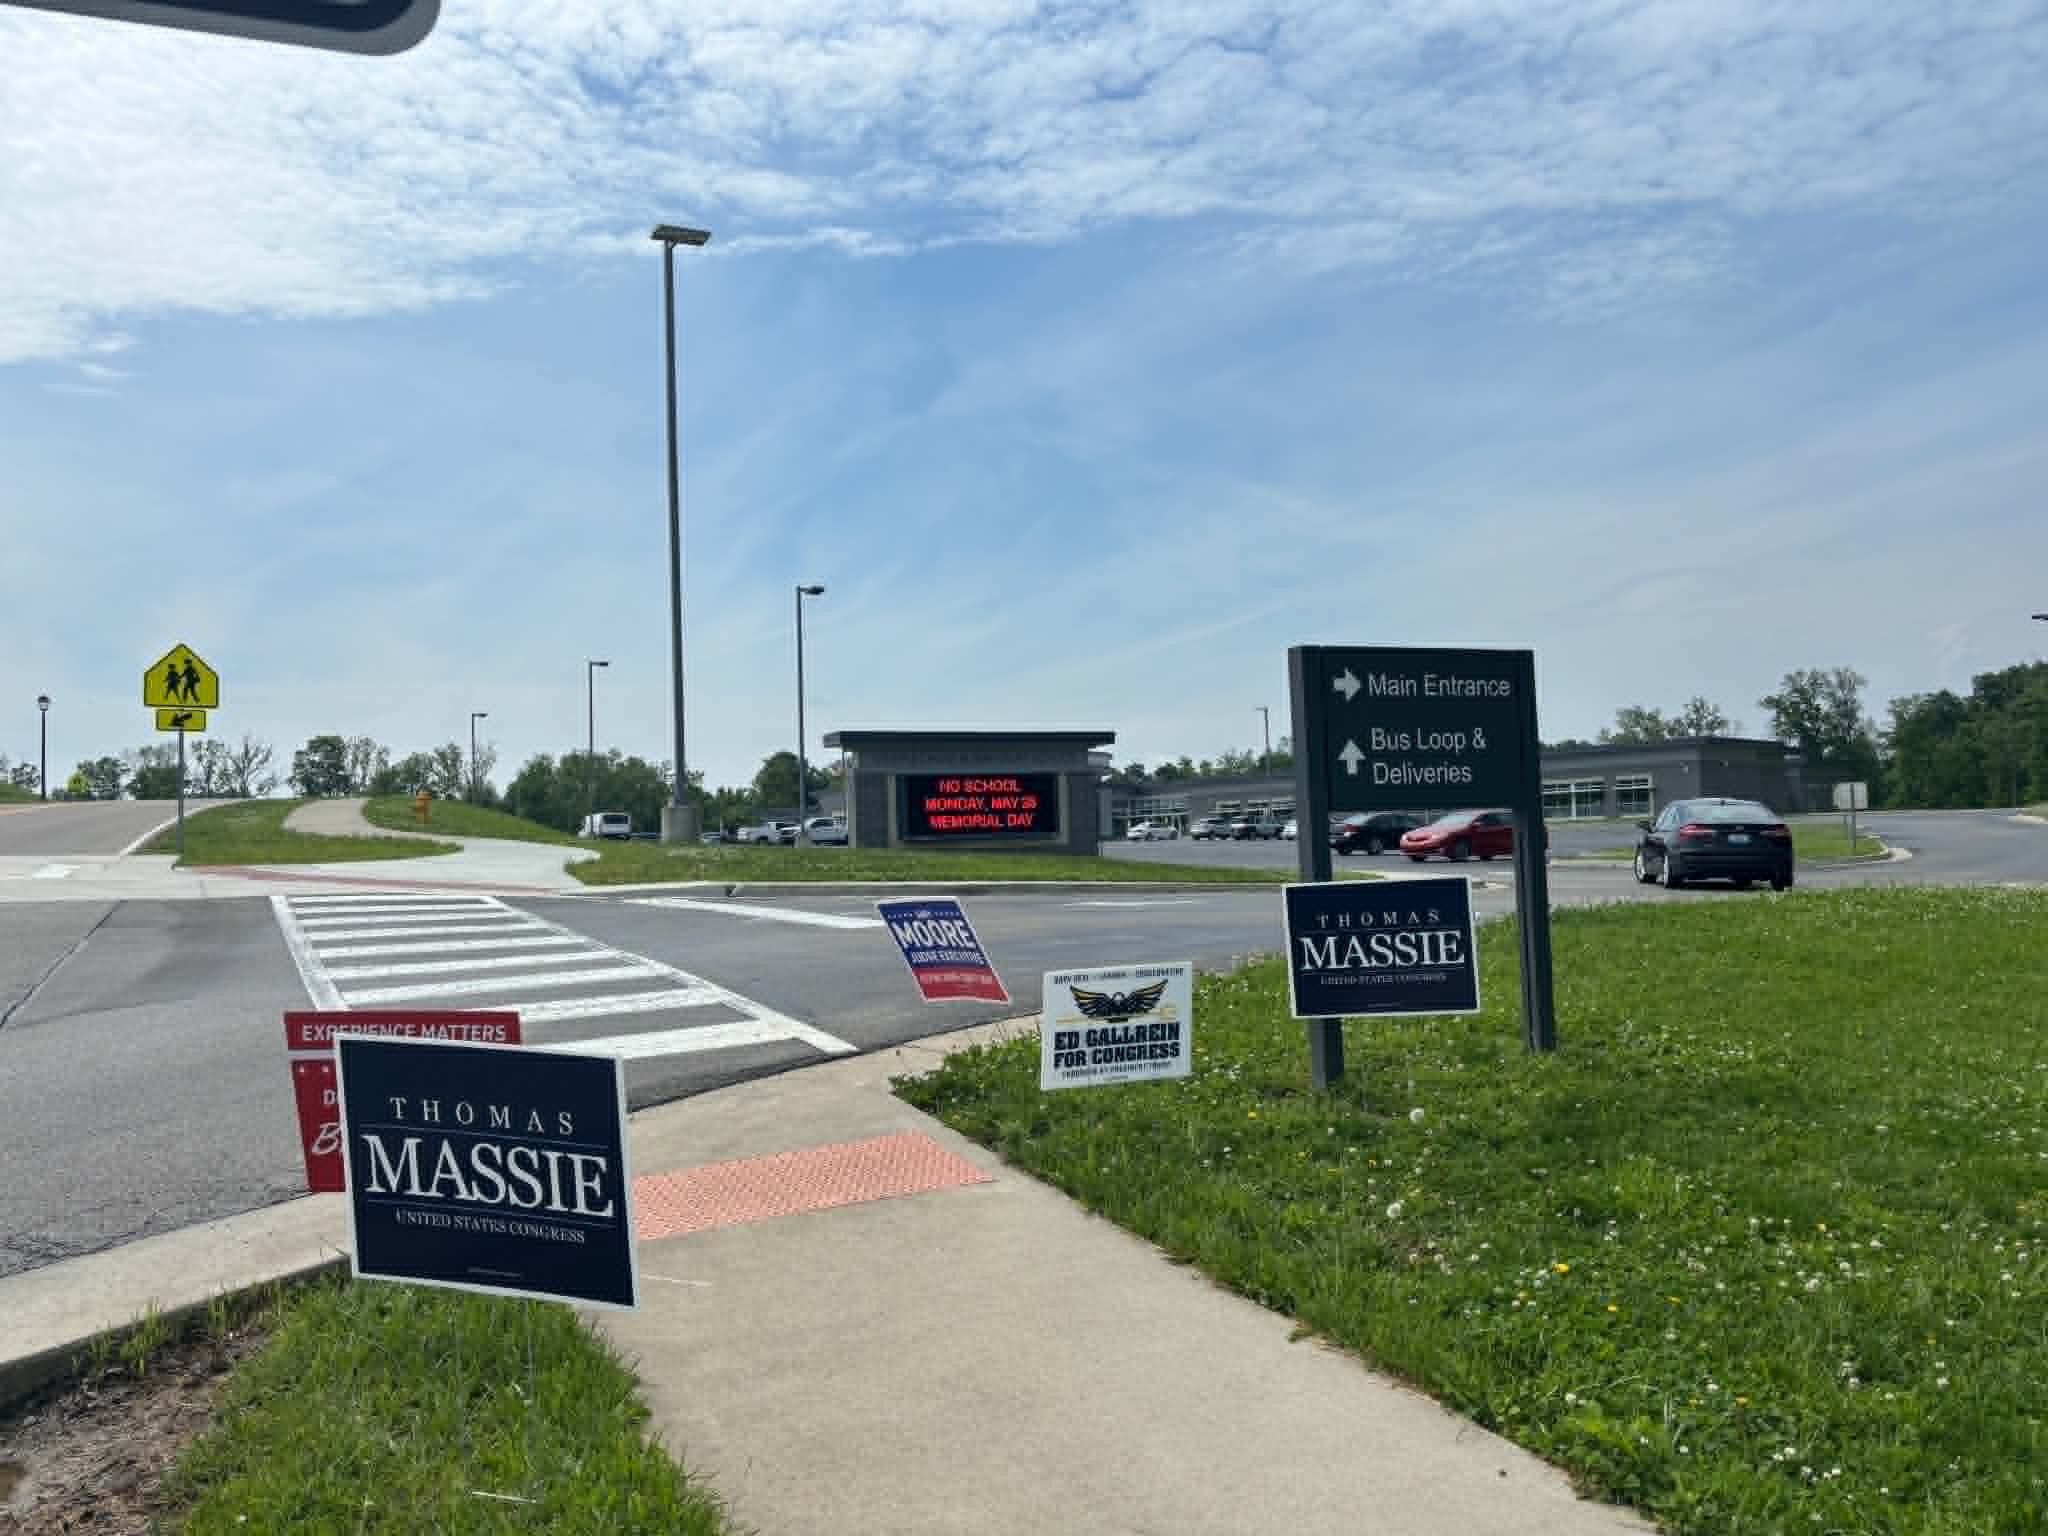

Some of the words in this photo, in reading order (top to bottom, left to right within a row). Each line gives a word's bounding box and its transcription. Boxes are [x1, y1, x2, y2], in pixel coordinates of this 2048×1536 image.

[1367, 673, 1417, 697] Main
[1423, 673, 1512, 697] Entrance
[1370, 727, 1411, 750] Bus
[1416, 727, 1467, 755] Loop
[1471, 727, 1488, 750] &
[1372, 759, 1473, 785] Deliveries
[939, 779, 960, 793] NO
[963, 779, 1021, 793] SCHOOL
[991, 796, 1019, 809] MAY
[930, 814, 1005, 829] MEMORIAL
[1007, 813, 1033, 827] DAY
[1315, 908, 1440, 928] THOMAS
[890, 918, 977, 949] MOORE
[1296, 930, 1465, 970] MASSIE
[421, 1024, 507, 1041] MATTERS
[1054, 1031, 1079, 1051] ED
[1053, 1050, 1087, 1069] FOR
[1091, 1042, 1180, 1065] CONGRESS
[389, 1097, 574, 1136] THOMAS
[360, 1134, 615, 1217] MASSIE
[395, 1208, 451, 1226] UNITED
[453, 1215, 506, 1233] STATES
[511, 1223, 585, 1244] CONGRESS
